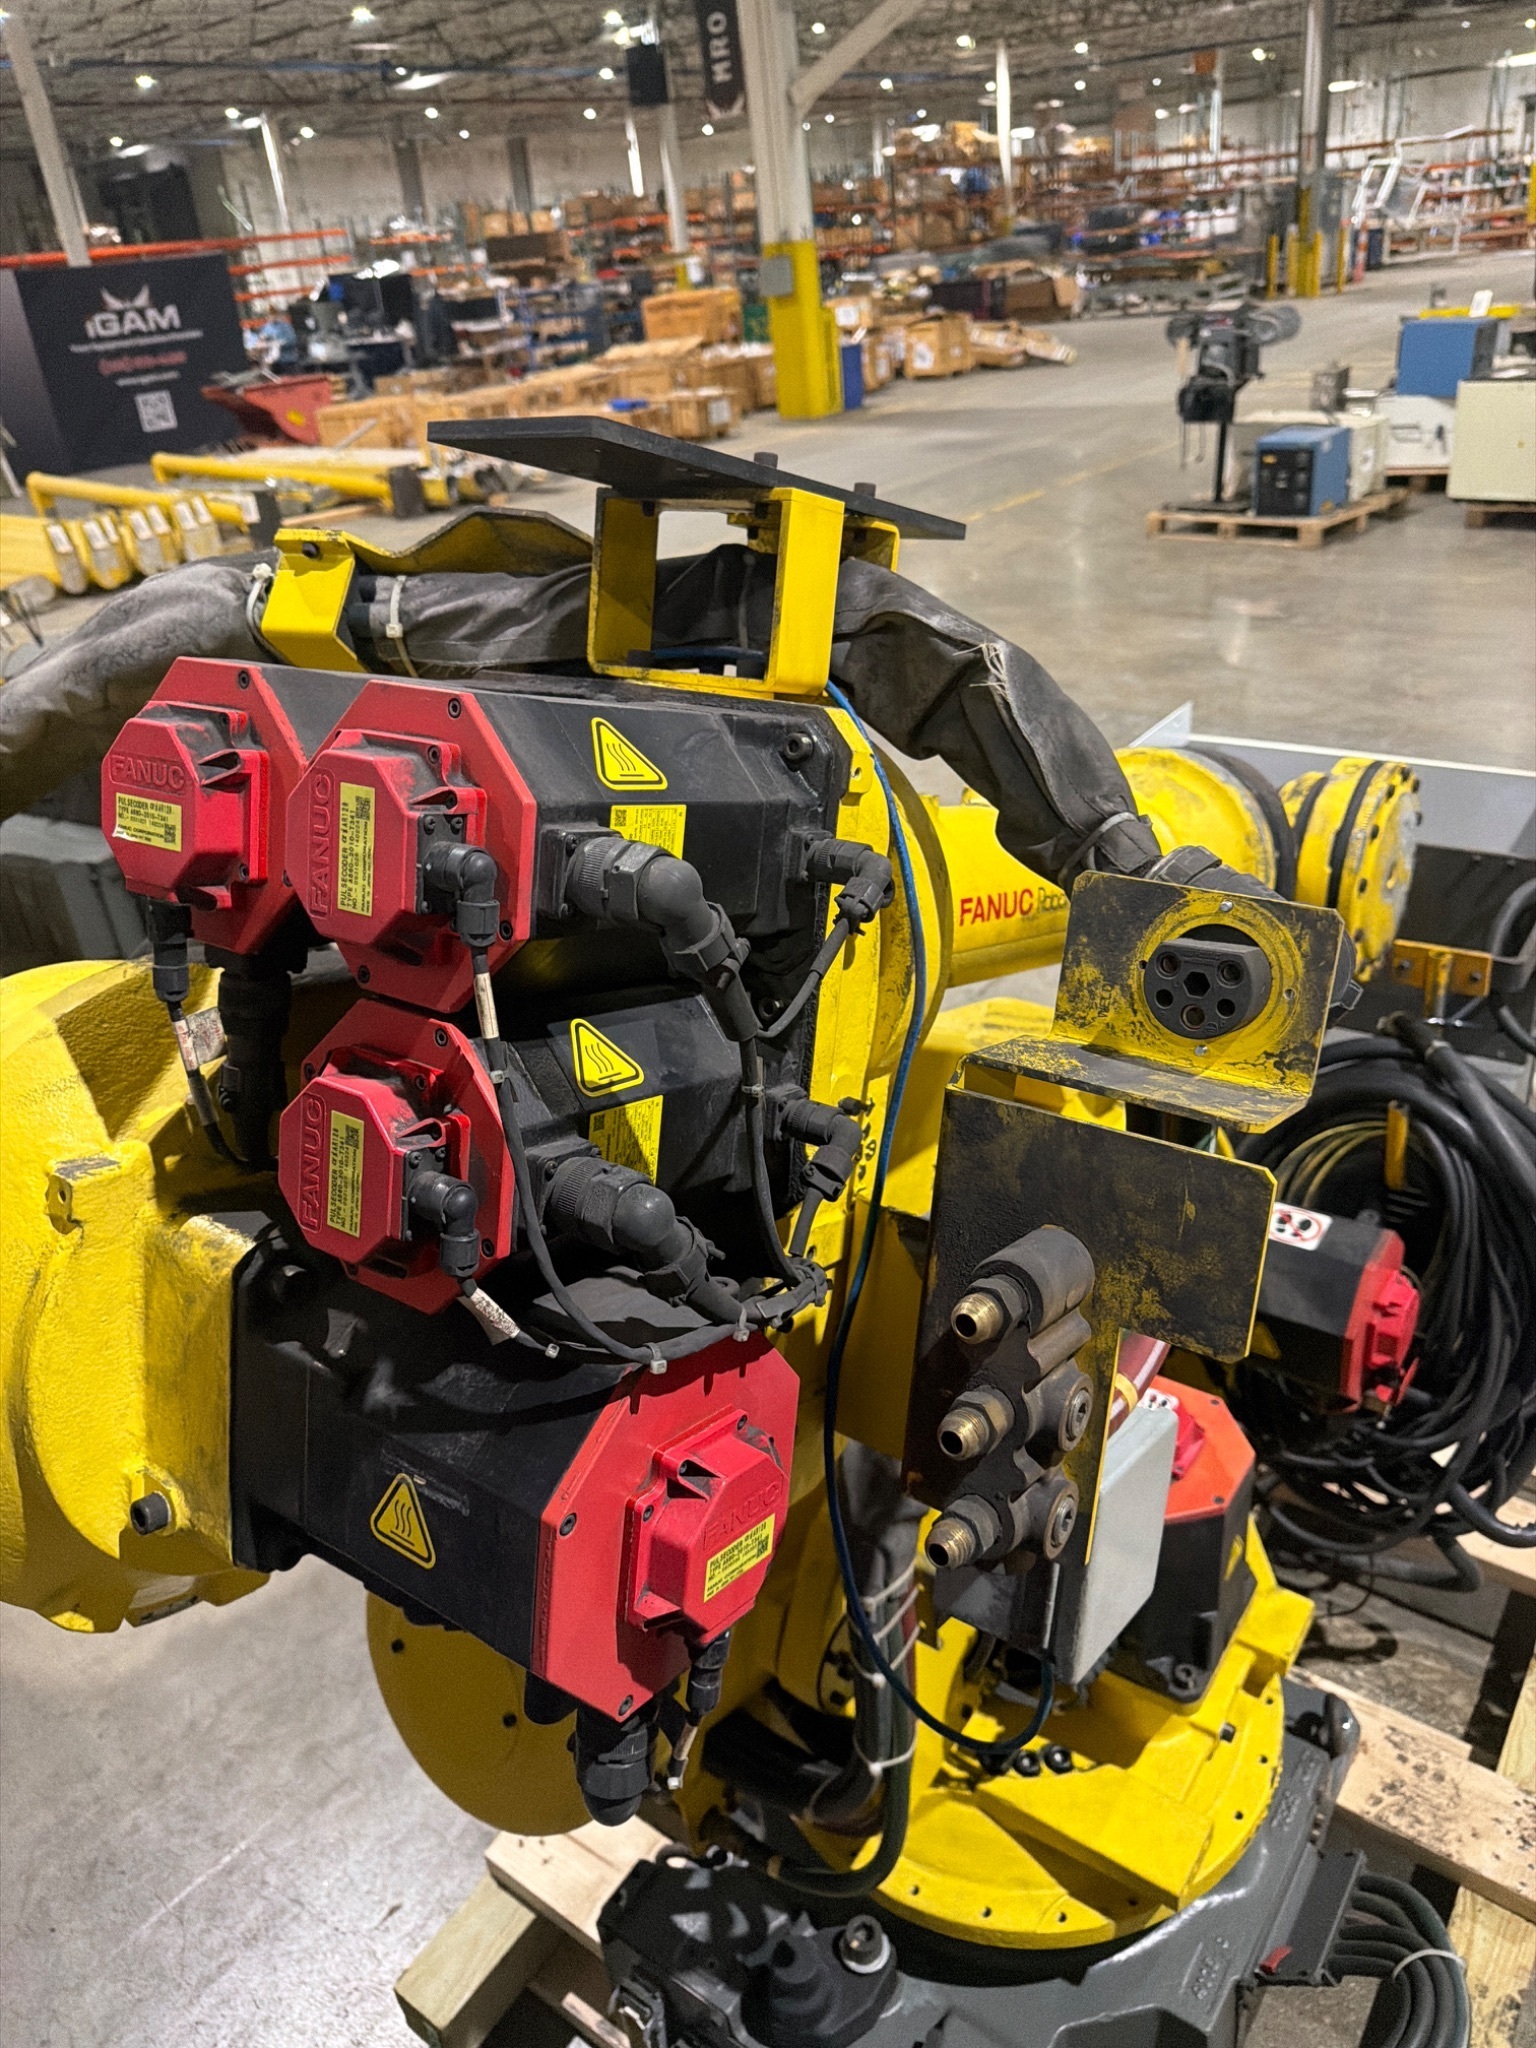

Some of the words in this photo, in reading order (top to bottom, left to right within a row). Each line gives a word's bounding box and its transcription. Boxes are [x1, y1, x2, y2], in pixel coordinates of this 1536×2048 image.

[111, 754, 185, 790] FANUC
[310, 772, 331, 914] FANUC
[340, 847, 348, 906] PULSECODER
[959, 888, 1034, 927] FANUC
[1098, 983, 1113, 1018] WELD
[302, 1098, 322, 1227] FANUC
[330, 1169, 338, 1223] PULSECODER
[703, 1481, 780, 1551] FANUC
